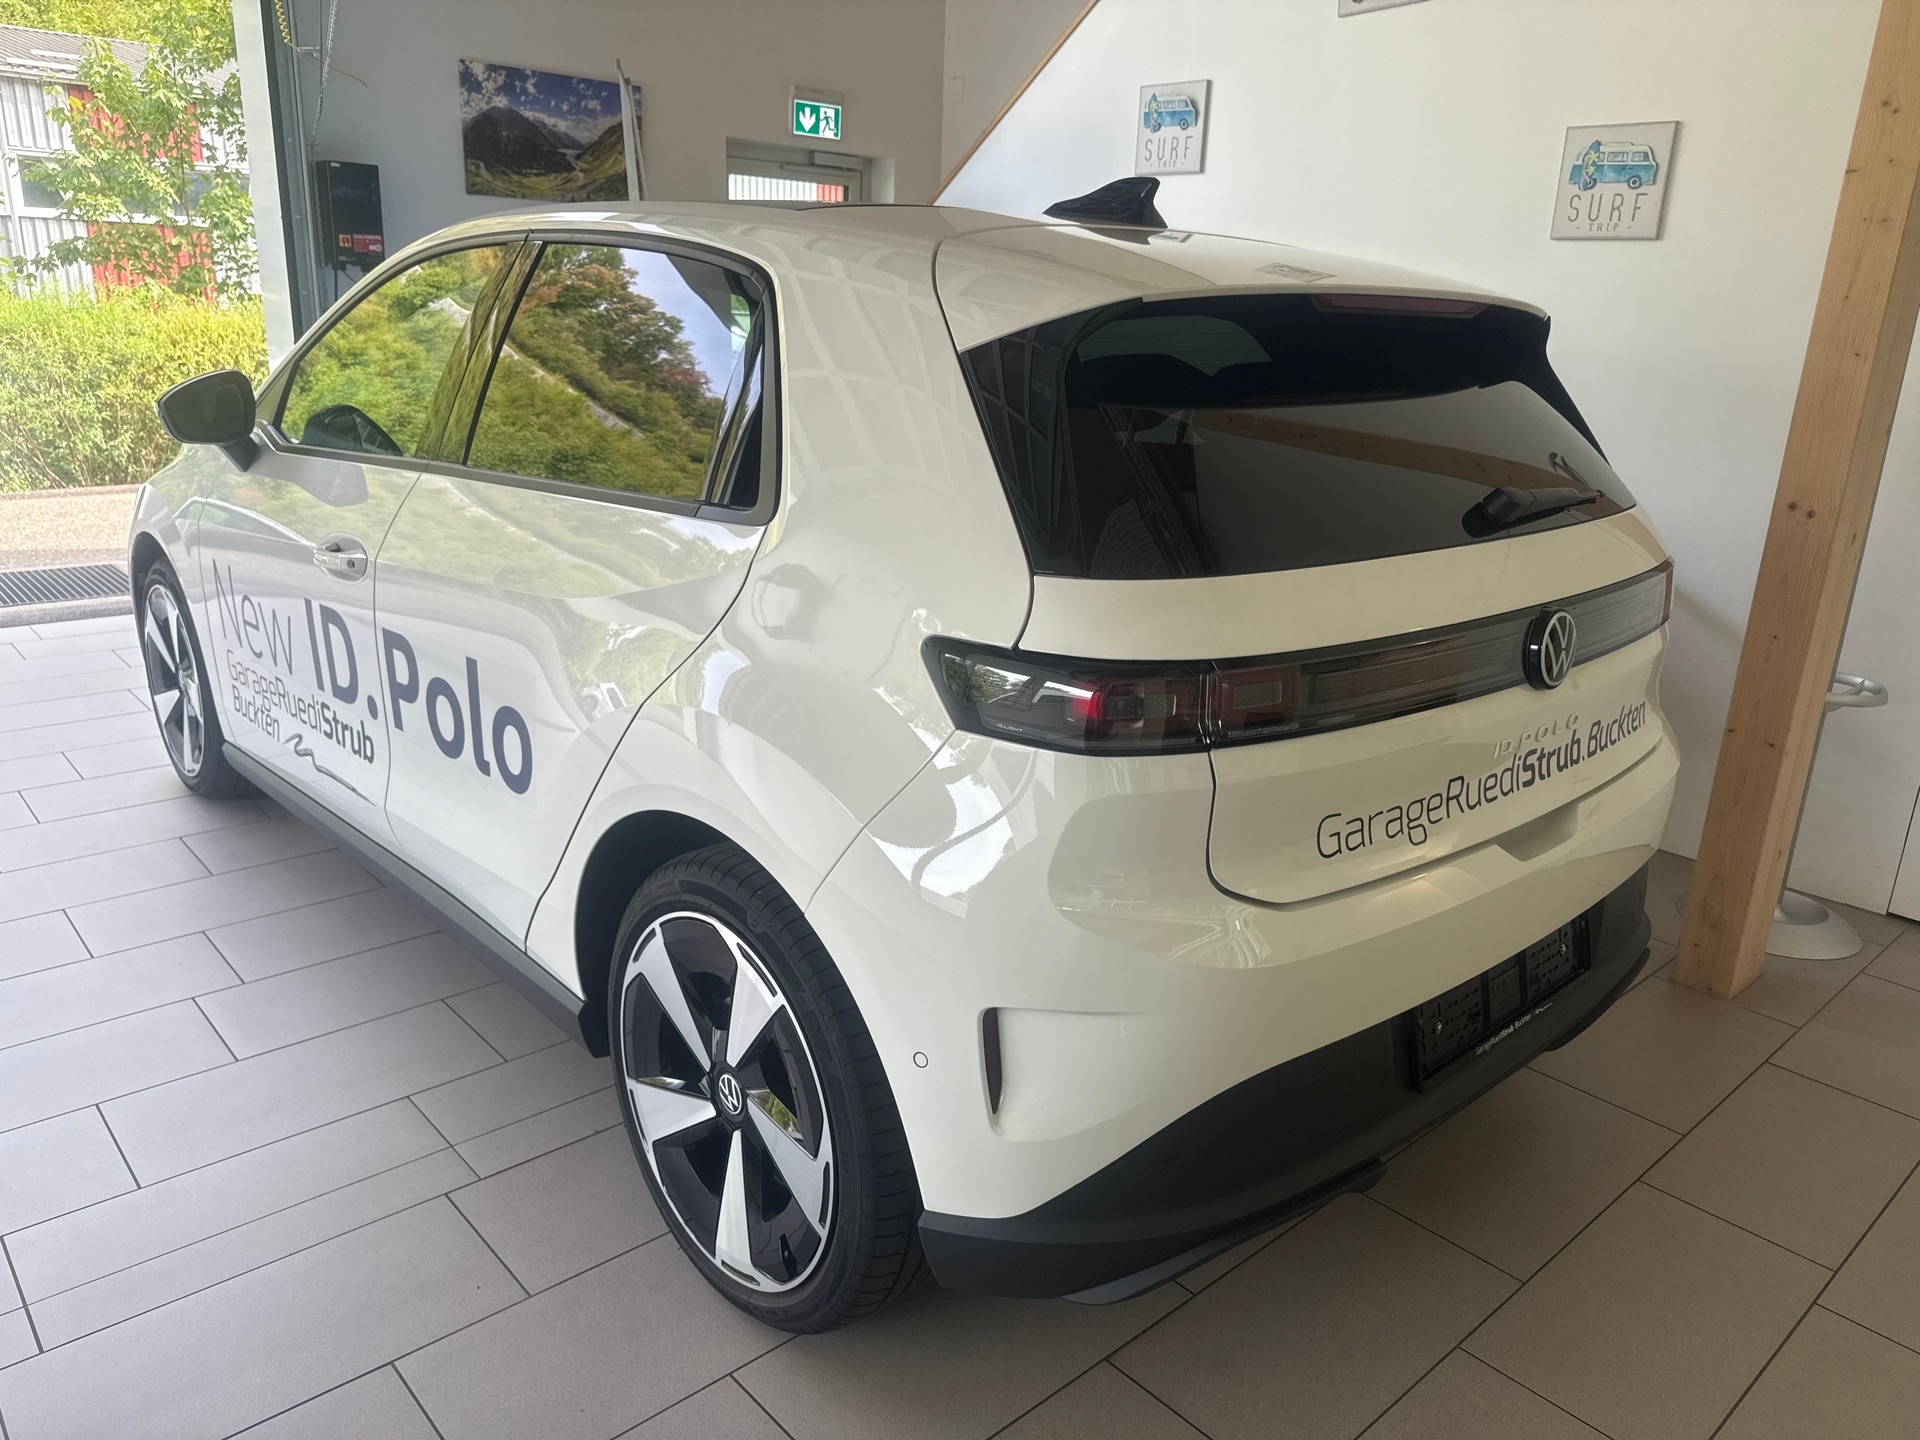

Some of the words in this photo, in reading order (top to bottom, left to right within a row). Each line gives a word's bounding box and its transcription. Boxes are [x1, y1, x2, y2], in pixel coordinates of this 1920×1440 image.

[1144, 135, 1194, 162] SURF
[1567, 193, 1648, 222] SURF
[1588, 223, 1620, 232] TRIP
[212, 558, 293, 676] New
[226, 649, 375, 765] GarageRuediStrub
[232, 686, 282, 743] Buckten
